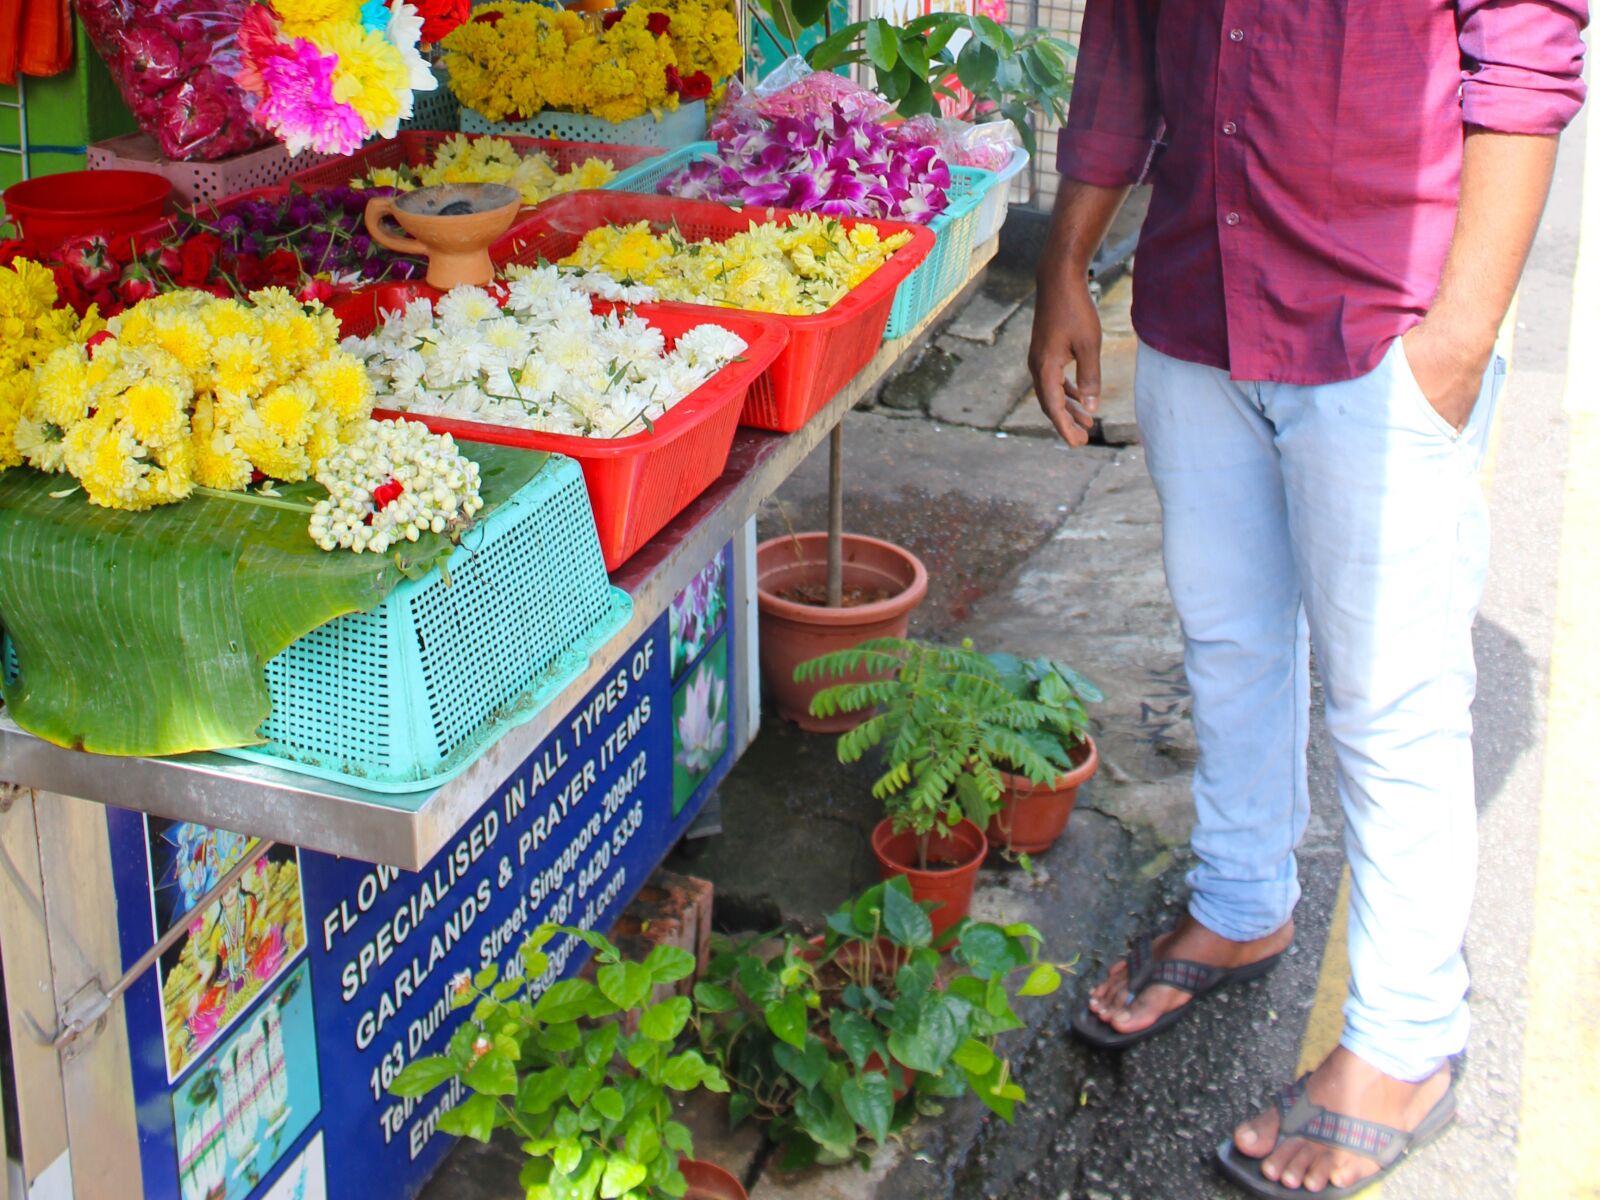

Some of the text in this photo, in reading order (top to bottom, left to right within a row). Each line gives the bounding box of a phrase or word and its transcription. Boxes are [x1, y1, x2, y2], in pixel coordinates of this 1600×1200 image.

[323, 863, 401, 951] FLOW
[341, 809, 499, 1002] SPECIALISED
[504, 778, 526, 824] IN
[530, 738, 568, 797] ALL
[571, 668, 628, 747] TYPES
[631, 638, 654, 682] OF
[355, 878, 491, 1050] GARLANDS
[498, 856, 513, 889] &
[518, 759, 597, 866] PRAYER
[600, 695, 651, 772] ITEMS
[370, 1040, 404, 1102] 163
[408, 967, 473, 1059] Dunl
[480, 895, 528, 970] Street
[529, 812, 601, 911] Singapore
[601, 750, 647, 825] 209472
[578, 841, 611, 899] 8420
[612, 800, 643, 856] 5336
